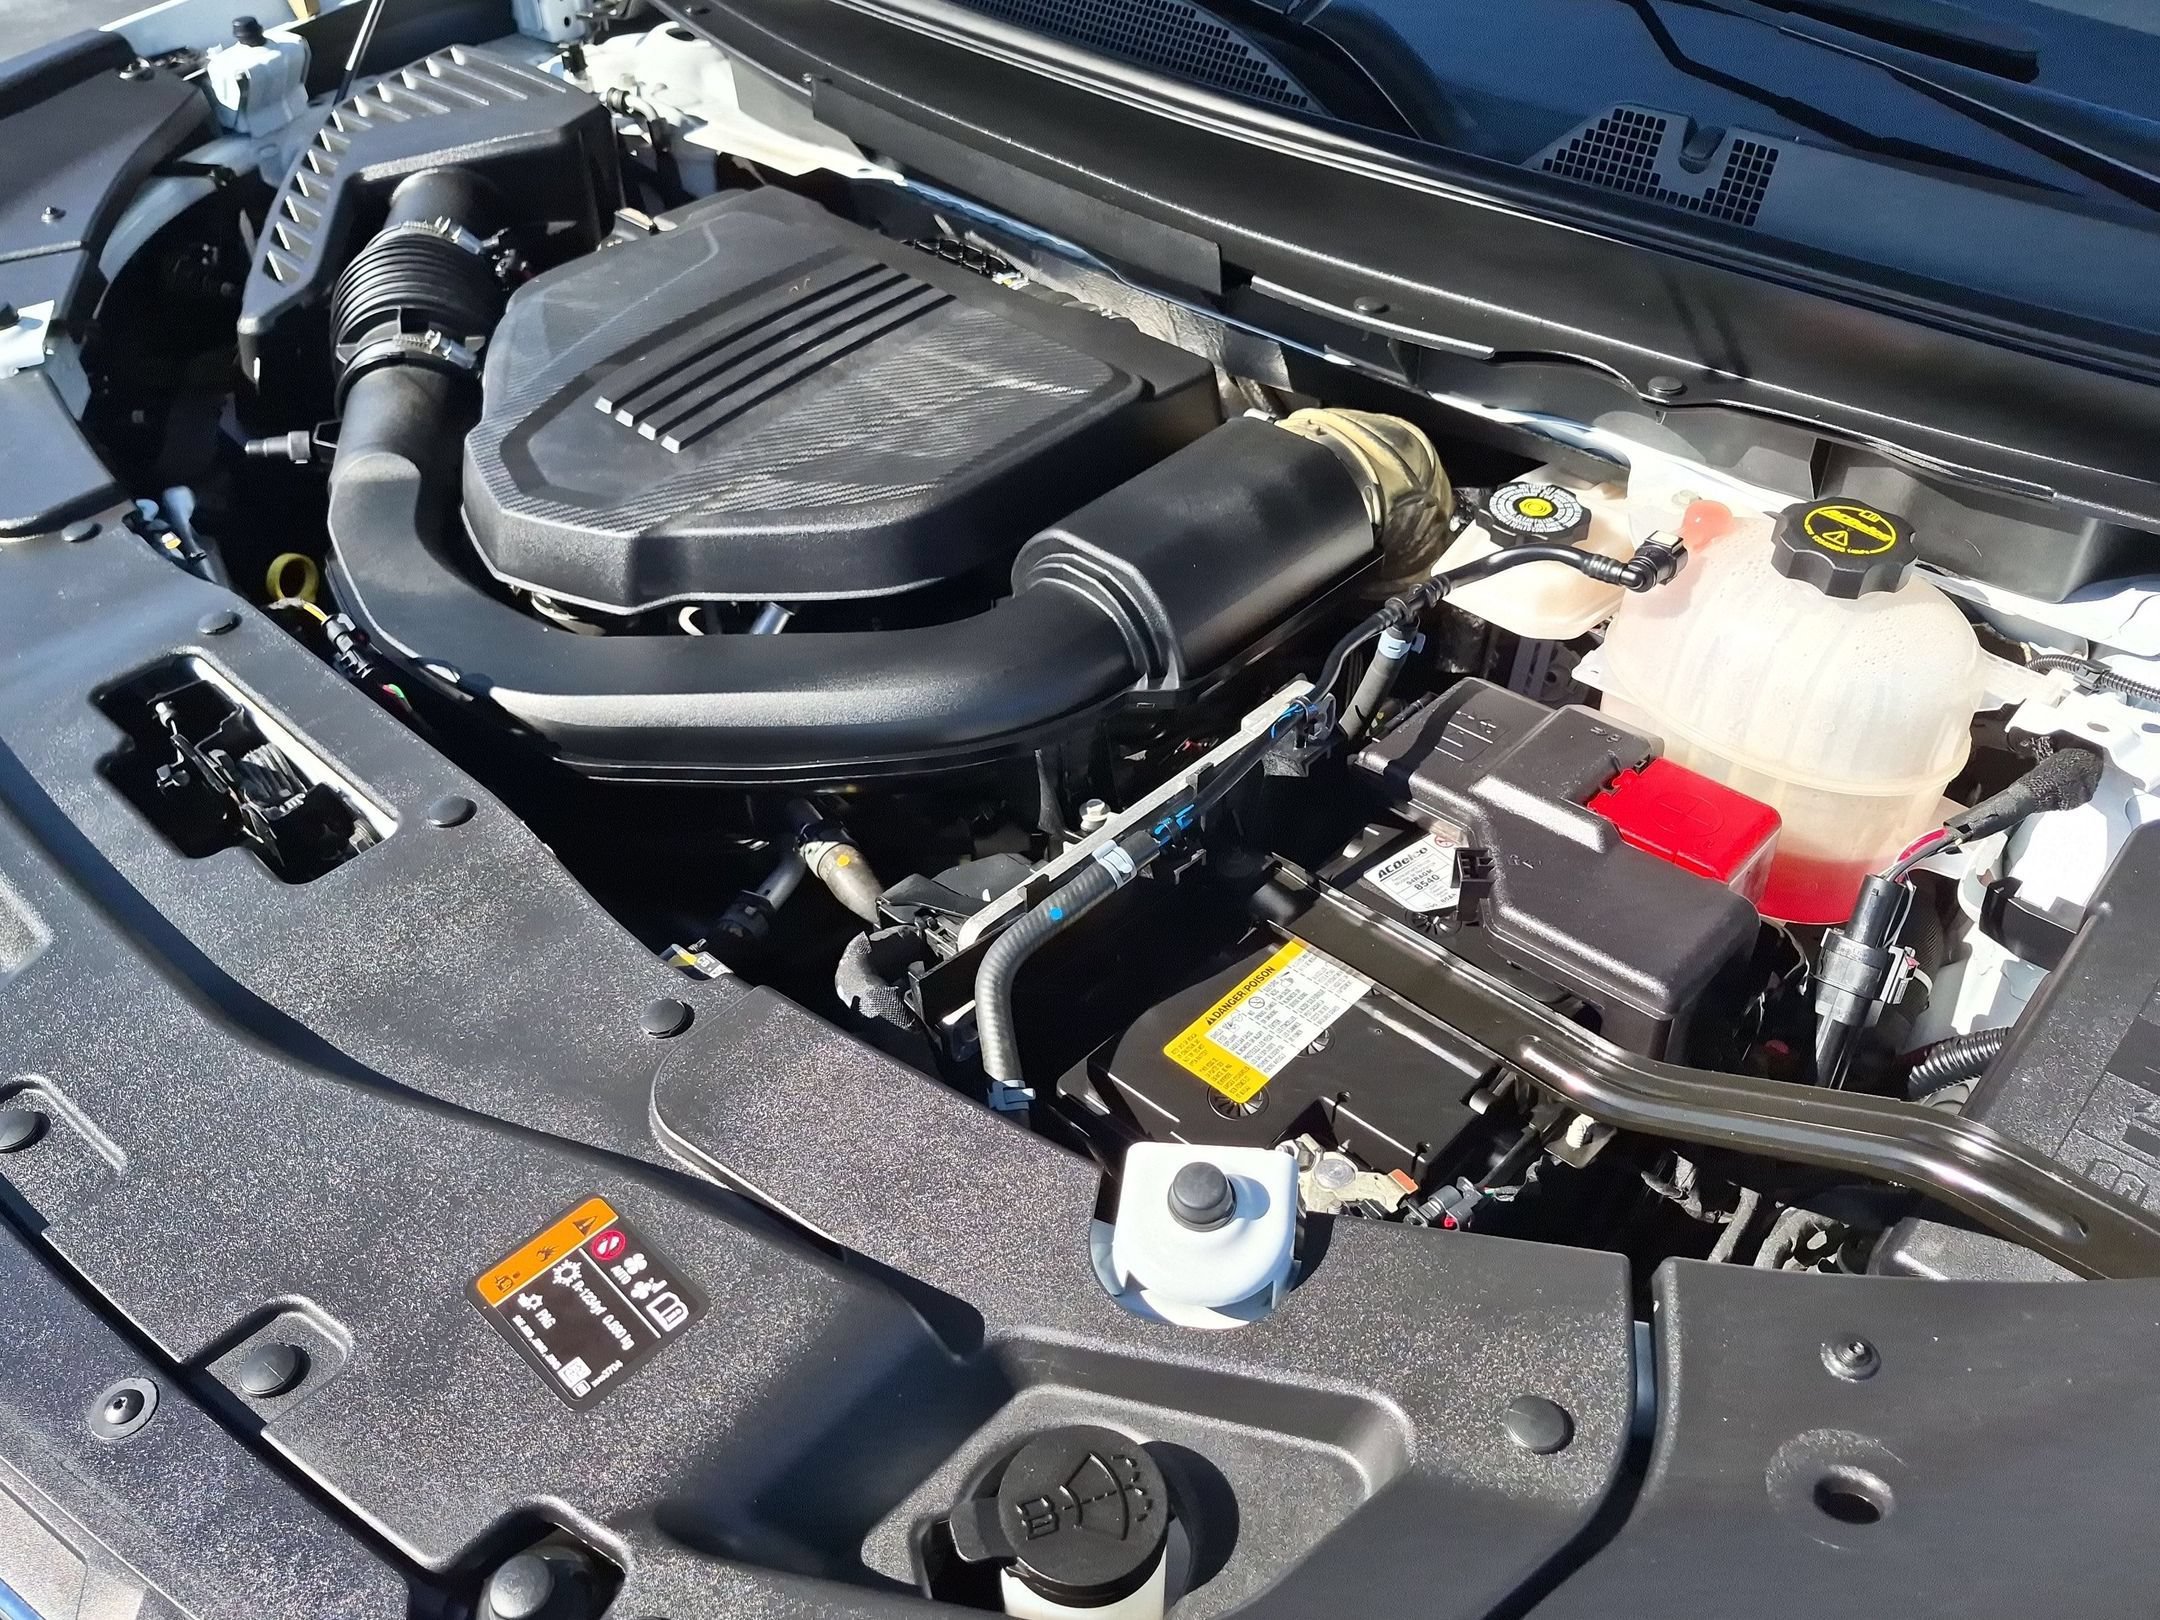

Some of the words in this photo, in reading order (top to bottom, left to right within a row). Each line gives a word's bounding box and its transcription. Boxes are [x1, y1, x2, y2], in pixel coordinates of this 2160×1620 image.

[1378, 847, 1428, 879] ACDelco
[1413, 874, 1440, 891] 8540
[610, 1265, 632, 1285] AUTO
[534, 1308, 556, 1330] PAG
[572, 1280, 607, 1316] R-1234yf
[620, 1333, 635, 1351] kg
